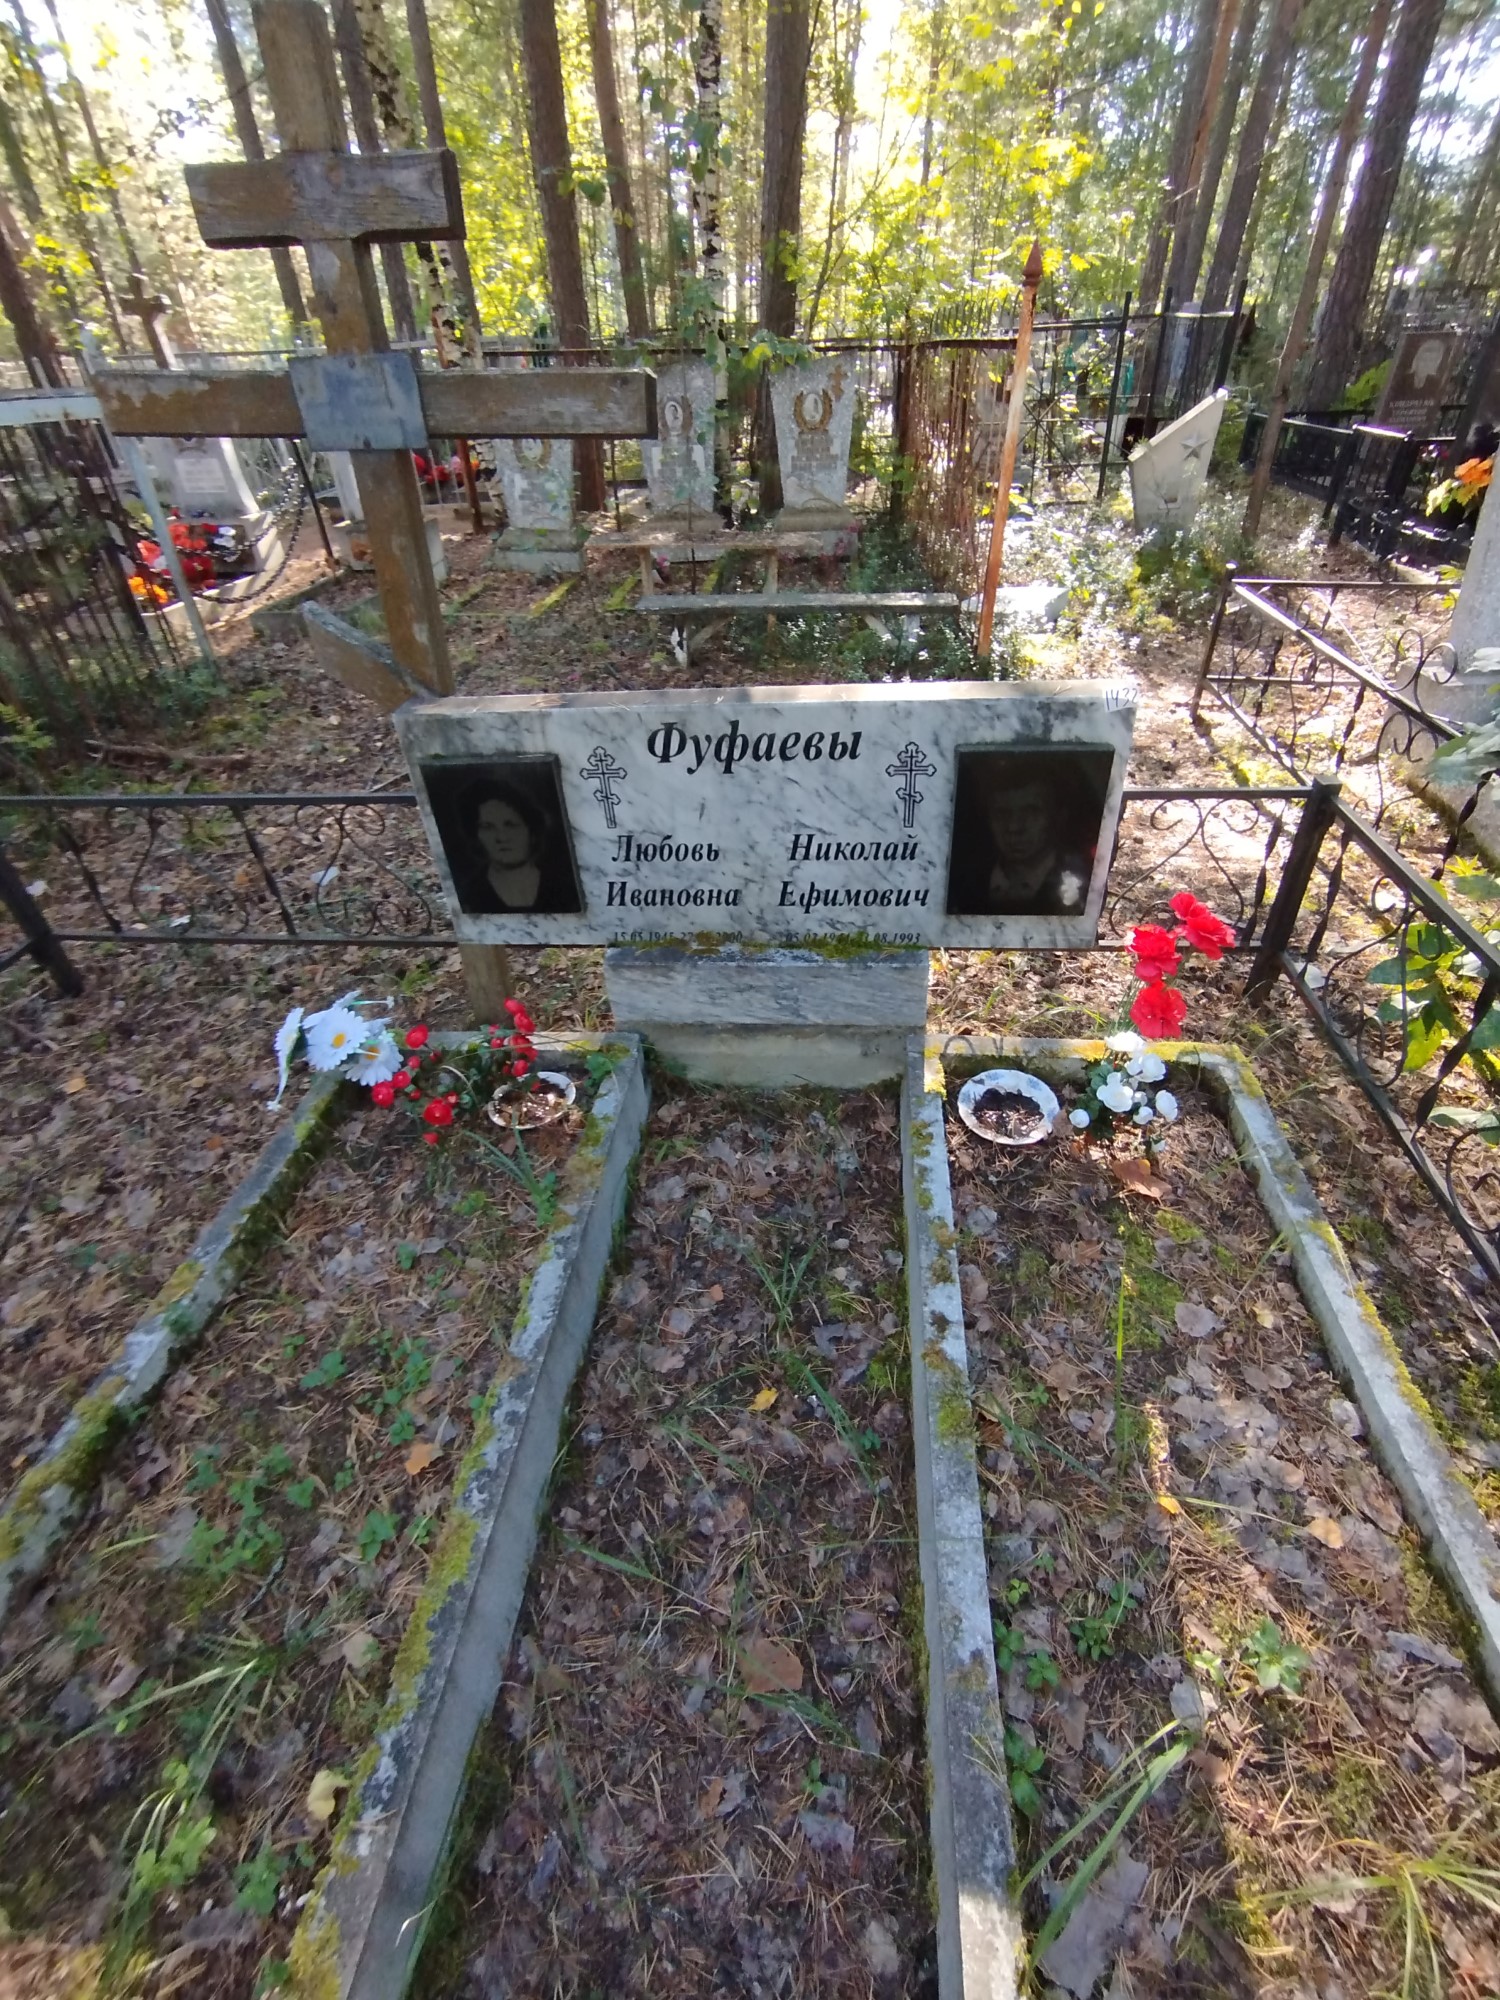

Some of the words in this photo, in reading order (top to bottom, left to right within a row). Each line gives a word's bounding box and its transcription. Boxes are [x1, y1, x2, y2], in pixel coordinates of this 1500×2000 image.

[1105, 687, 1138, 711] 1432
[647, 719, 863, 775] Фуфаевы
[611, 834, 720, 862] Любовь
[788, 833, 919, 862] Николай
[606, 881, 741, 907] Ивановна
[778, 880, 930, 914] Ефимович
